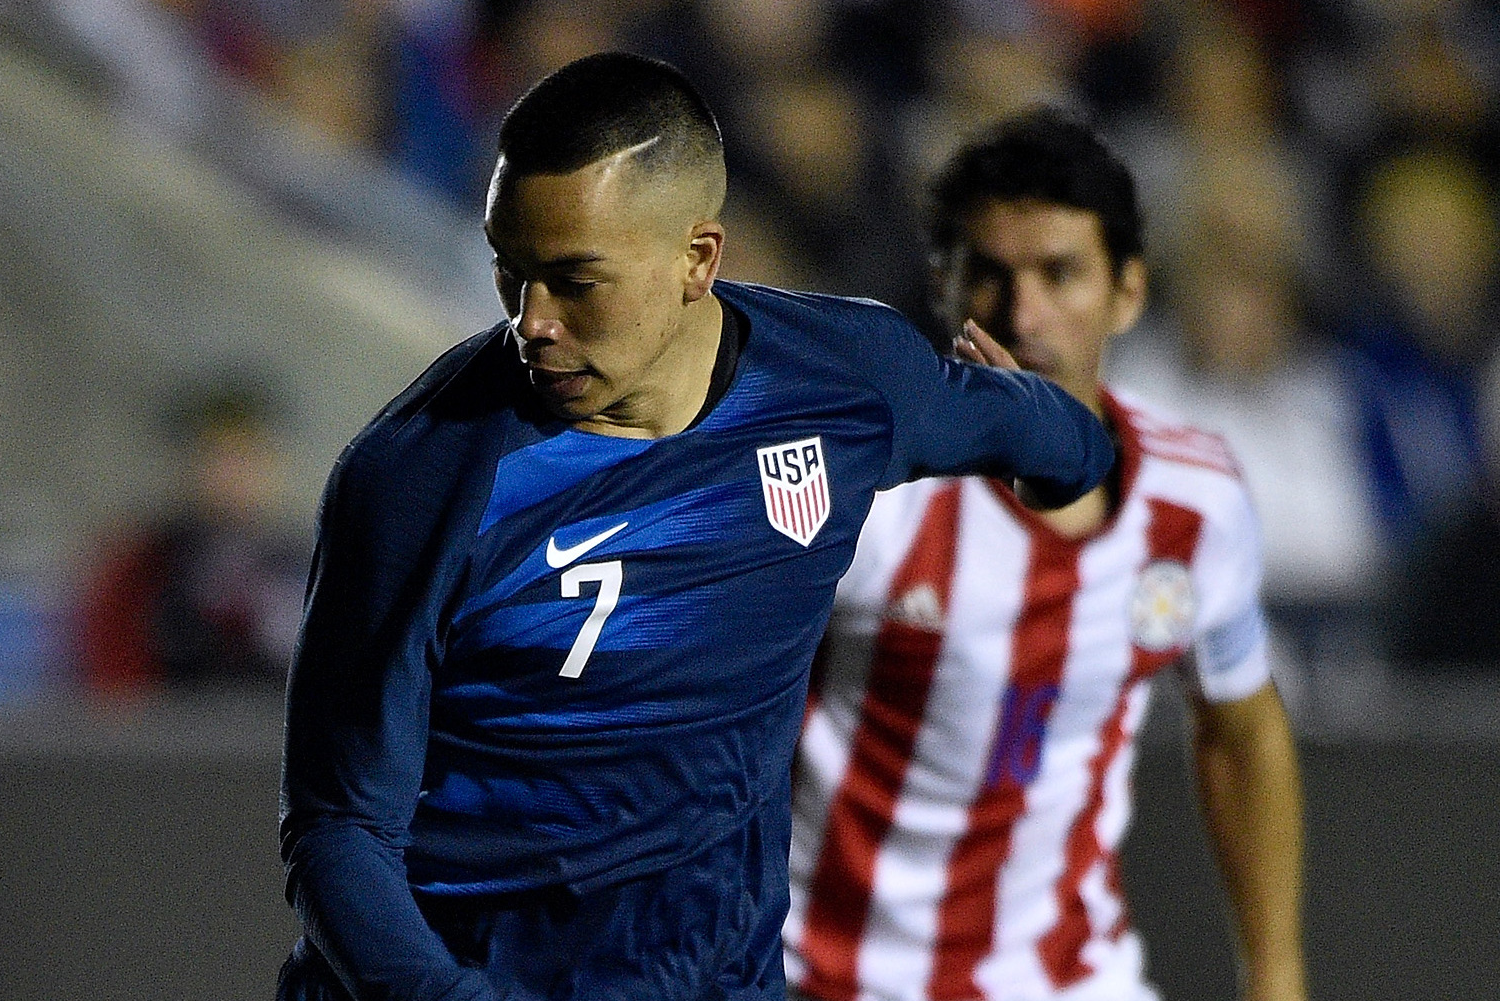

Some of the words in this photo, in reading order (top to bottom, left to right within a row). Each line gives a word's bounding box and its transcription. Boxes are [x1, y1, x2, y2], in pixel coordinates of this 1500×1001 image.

[763, 444, 820, 486] USA
[558, 561, 623, 679] 7
[987, 683, 1060, 786] 16
